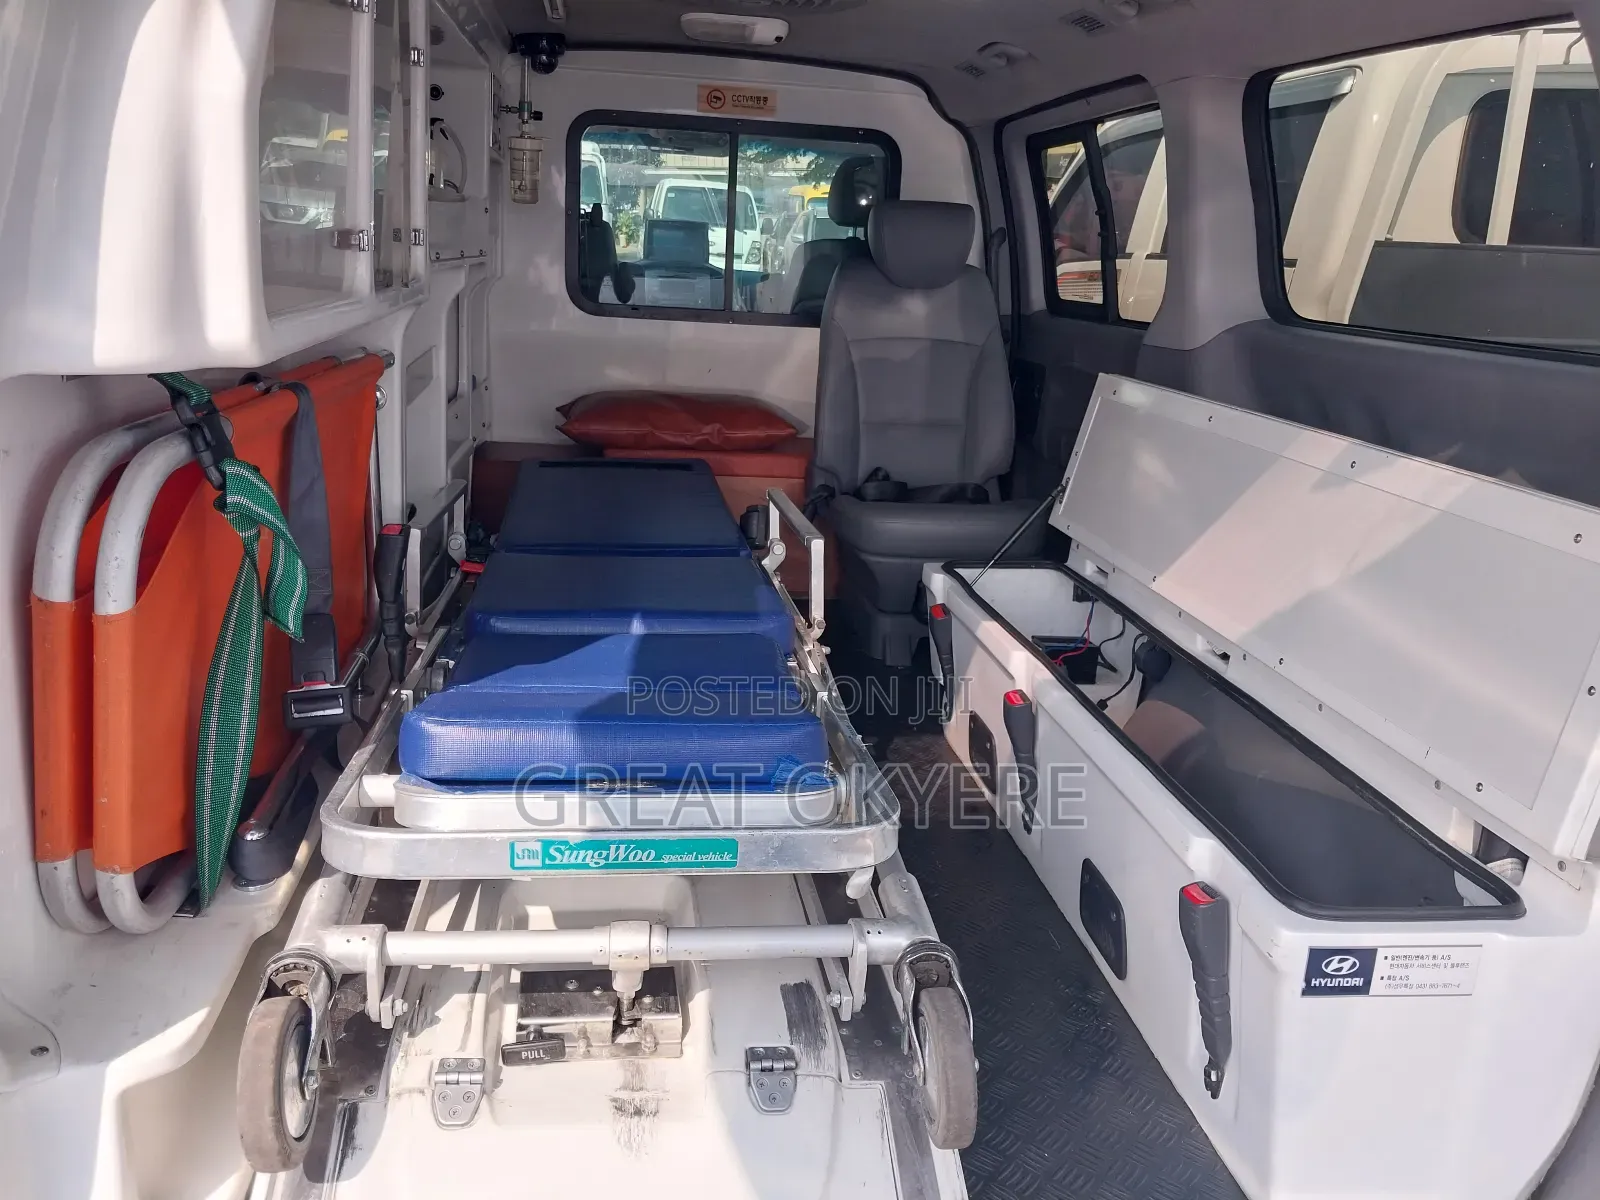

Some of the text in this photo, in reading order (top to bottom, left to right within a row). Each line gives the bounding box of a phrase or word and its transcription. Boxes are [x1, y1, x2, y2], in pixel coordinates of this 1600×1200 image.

[661, 851, 697, 863] special
[698, 851, 734, 862] vehicle
[1311, 977, 1364, 987] HYUNDAI
[1398, 974, 1410, 982] A/S
[521, 1049, 546, 1060] PULL
